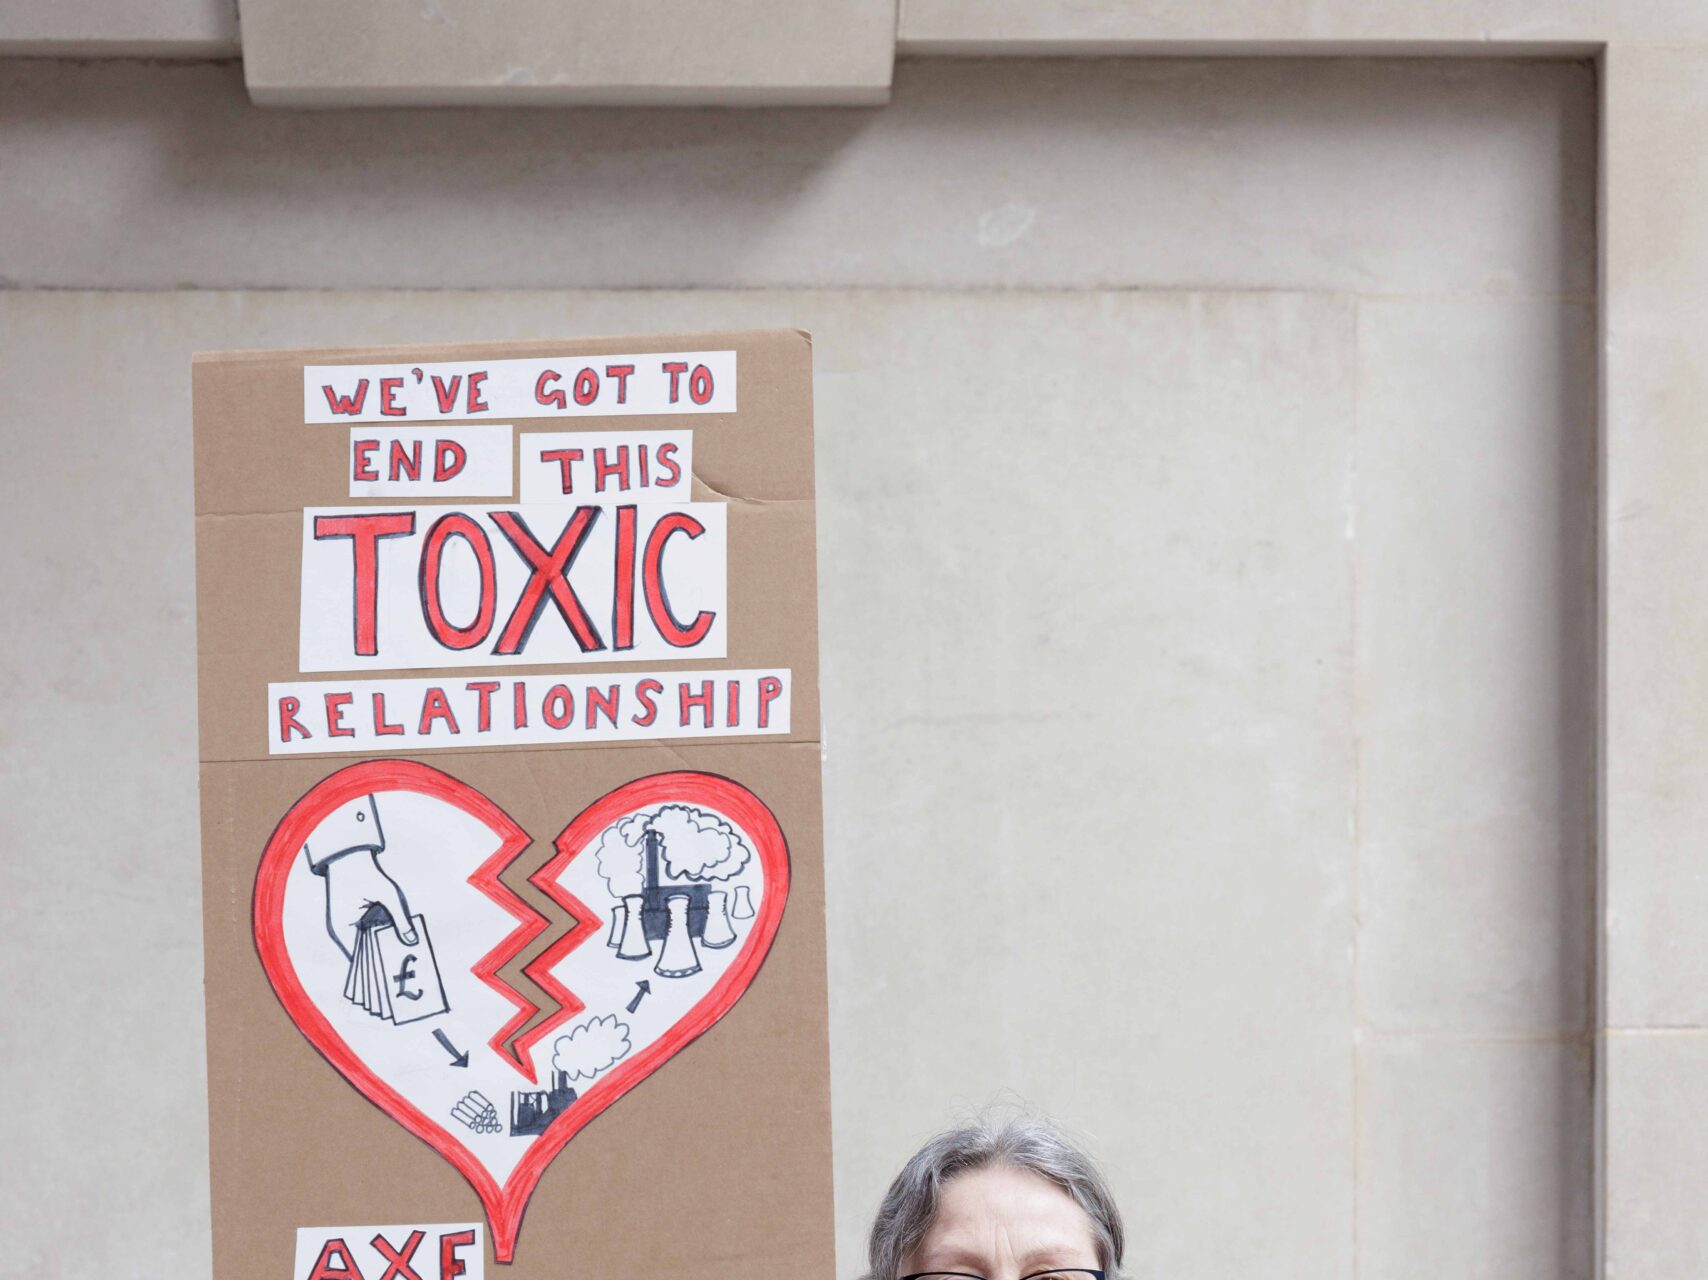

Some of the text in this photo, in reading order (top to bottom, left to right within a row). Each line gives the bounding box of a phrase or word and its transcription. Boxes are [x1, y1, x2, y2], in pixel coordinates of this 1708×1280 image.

[321, 361, 715, 417] WE'VE GOT TO
[353, 439, 682, 495] END THIS
[313, 503, 717, 657] TOXIC
[278, 676, 782, 743] RELATIONSHIP
[392, 953, 424, 1001] £
